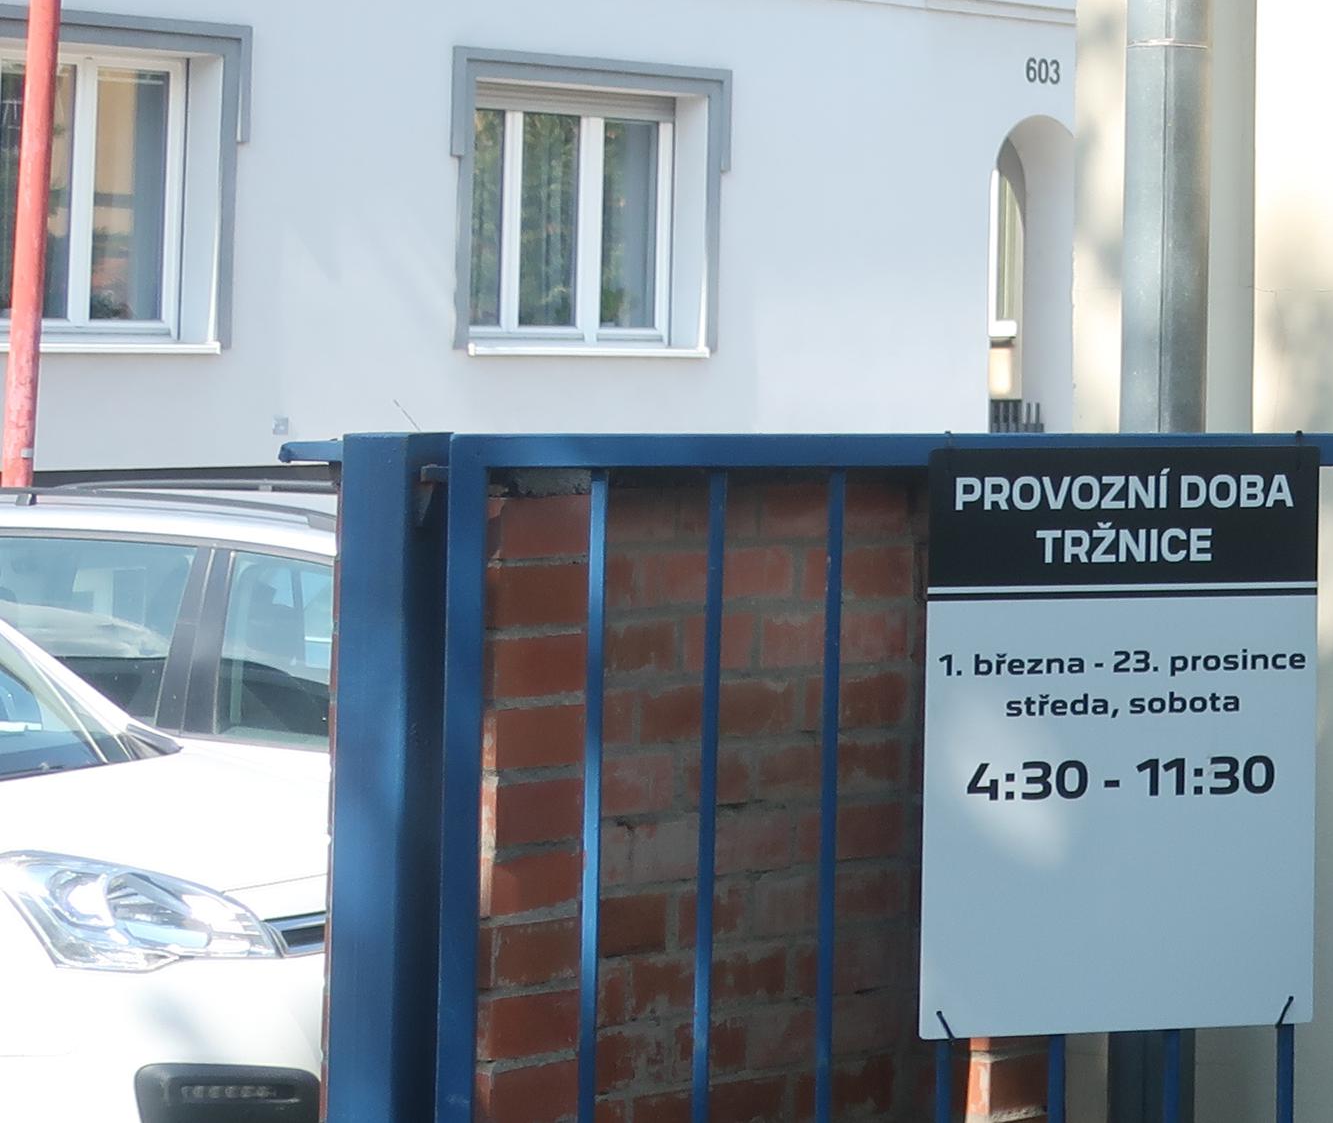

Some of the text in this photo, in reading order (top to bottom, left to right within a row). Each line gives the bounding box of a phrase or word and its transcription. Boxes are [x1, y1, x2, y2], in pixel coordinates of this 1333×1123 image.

[1025, 56, 1061, 85] 603
[954, 467, 1294, 512] PROVOZNÍ DOBA
[1036, 521, 1213, 564] TRŽNICE
[938, 653, 963, 677] 1.
[974, 652, 1085, 677] března
[1112, 649, 1159, 674] 23.
[1170, 648, 1306, 677] prosince
[1005, 691, 1240, 719] středa, sobota
[966, 759, 1089, 801] 4:30
[1135, 755, 1276, 797] 11:30
